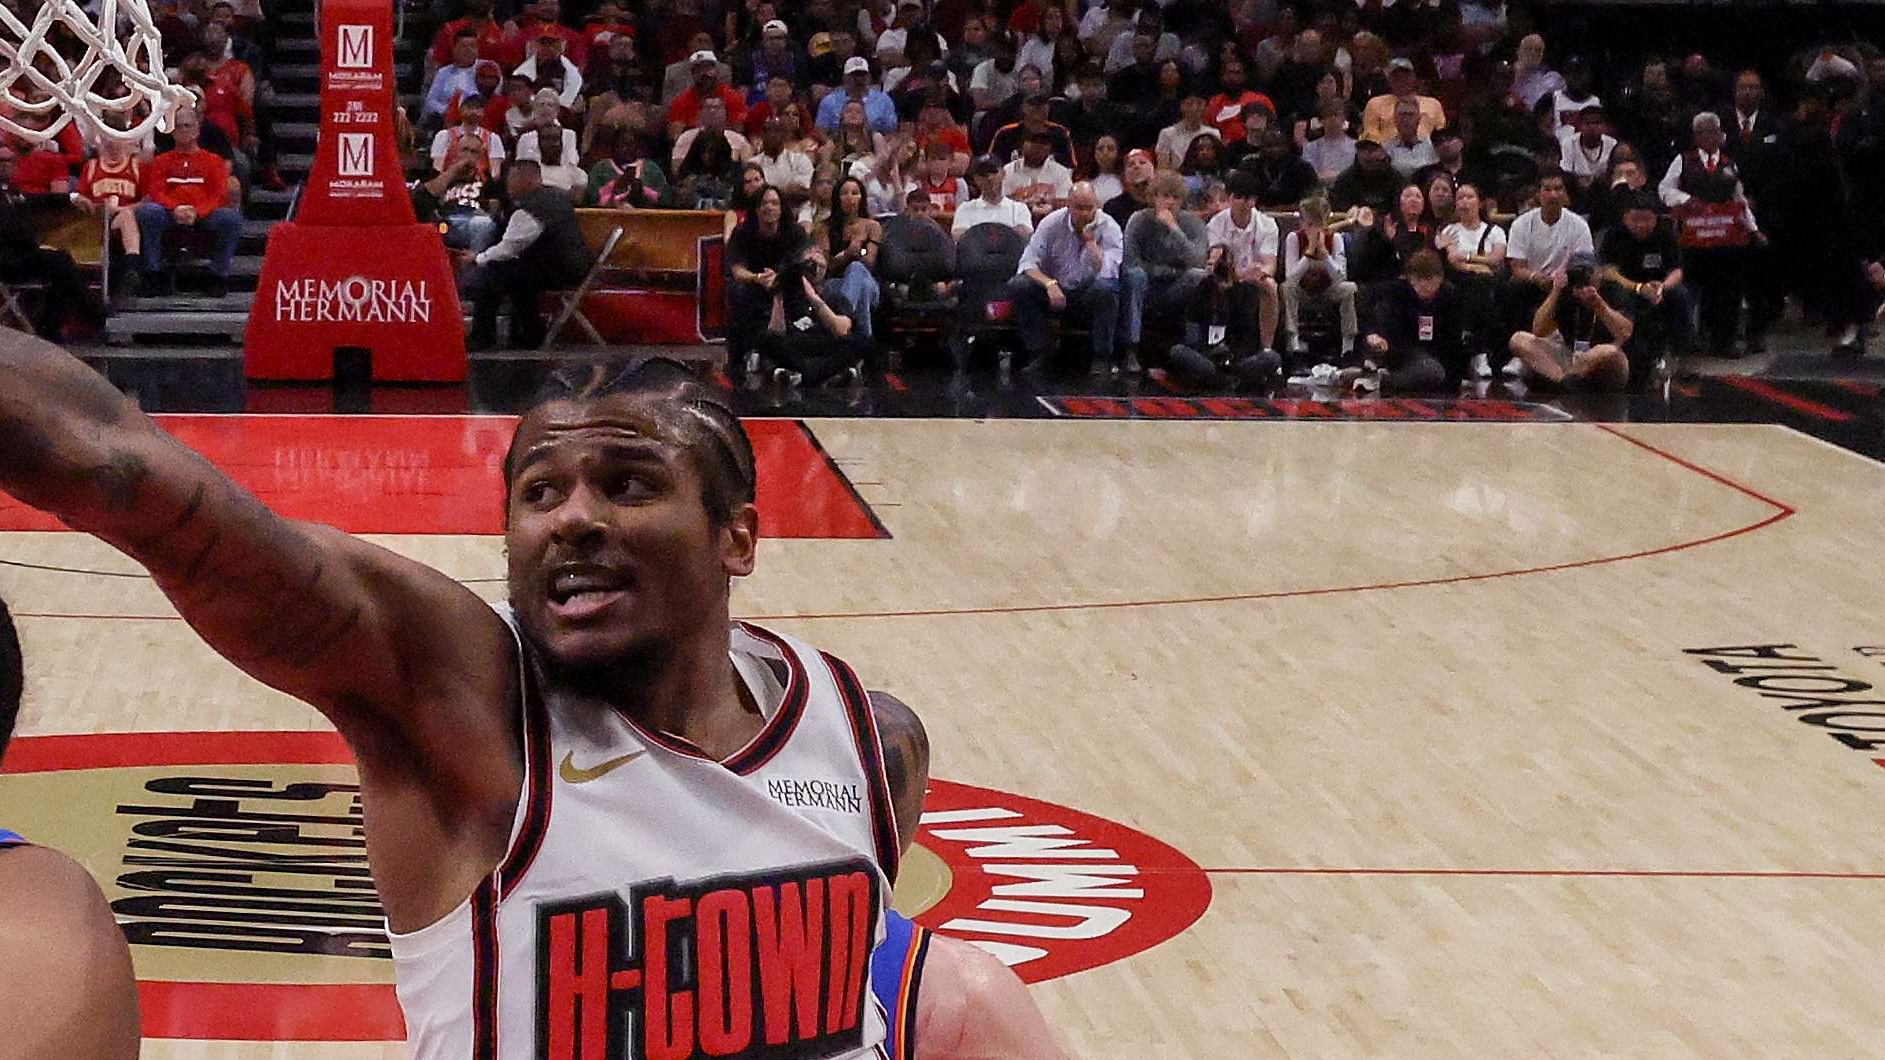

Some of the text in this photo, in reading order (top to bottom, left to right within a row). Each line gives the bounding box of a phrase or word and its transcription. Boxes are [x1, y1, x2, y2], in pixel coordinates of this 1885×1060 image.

[275, 276, 432, 303] MEMORIAL
[275, 299, 431, 323] HERMANN
[767, 779, 862, 801] MEMORIAL
